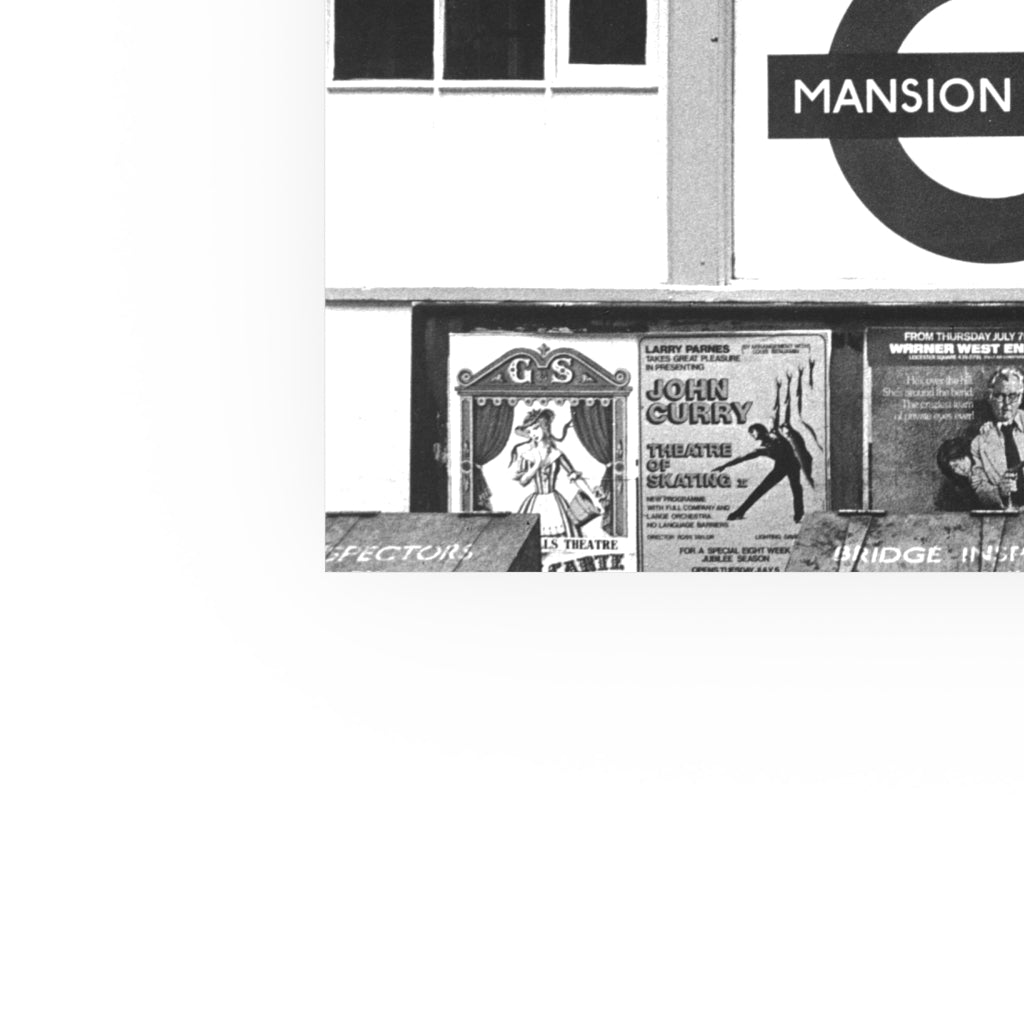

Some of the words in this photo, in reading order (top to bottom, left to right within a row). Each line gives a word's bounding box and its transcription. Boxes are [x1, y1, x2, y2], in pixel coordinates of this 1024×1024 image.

[794, 77, 1011, 114] MANSION
[904, 332, 934, 341] FROM
[936, 332, 991, 341] THURSDAY
[993, 332, 1016, 341] JULY
[645, 345, 682, 354] LARRY
[685, 344, 730, 354] PARNES
[889, 343, 954, 354] WARNER
[957, 343, 1001, 354] WEST
[646, 355, 671, 363] TAKES
[701, 355, 741, 363] PLEASURE
[646, 378, 729, 401] JOHN
[646, 401, 753, 425] CURRY
[646, 443, 733, 458] THEATRE
[646, 460, 670, 472] OF
[646, 473, 732, 488] SKATING
[563, 539, 619, 550] THEATRE
[702, 555, 733, 563] JUBILEE
[736, 555, 770, 563] SEASON
[833, 545, 942, 563] BRIDGE
